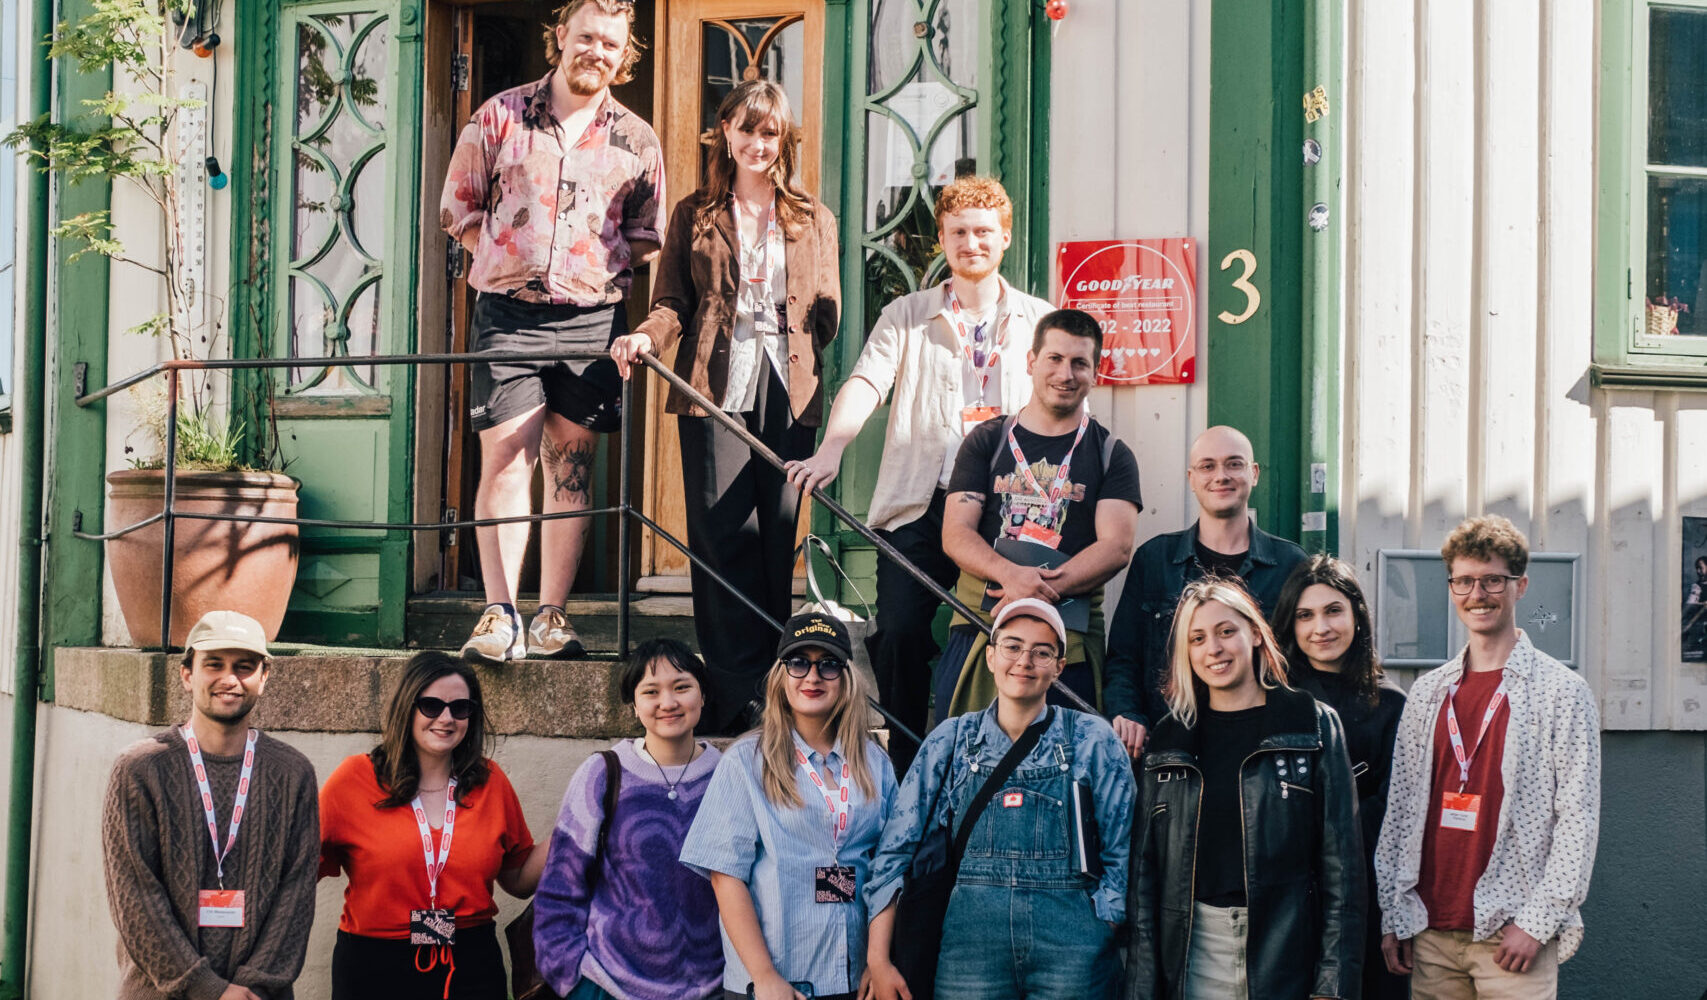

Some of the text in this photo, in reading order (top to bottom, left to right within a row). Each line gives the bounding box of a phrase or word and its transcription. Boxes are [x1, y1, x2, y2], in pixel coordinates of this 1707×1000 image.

[1076, 276, 1175, 293] GOODYEAR
[1217, 248, 1261, 325] 3
[1076, 302, 1111, 311] Certificate
[1112, 302, 1120, 310] of
[1100, 320, 1117, 334] 02
[1133, 318, 1172, 333] 2022
[794, 625, 837, 637] Originals
